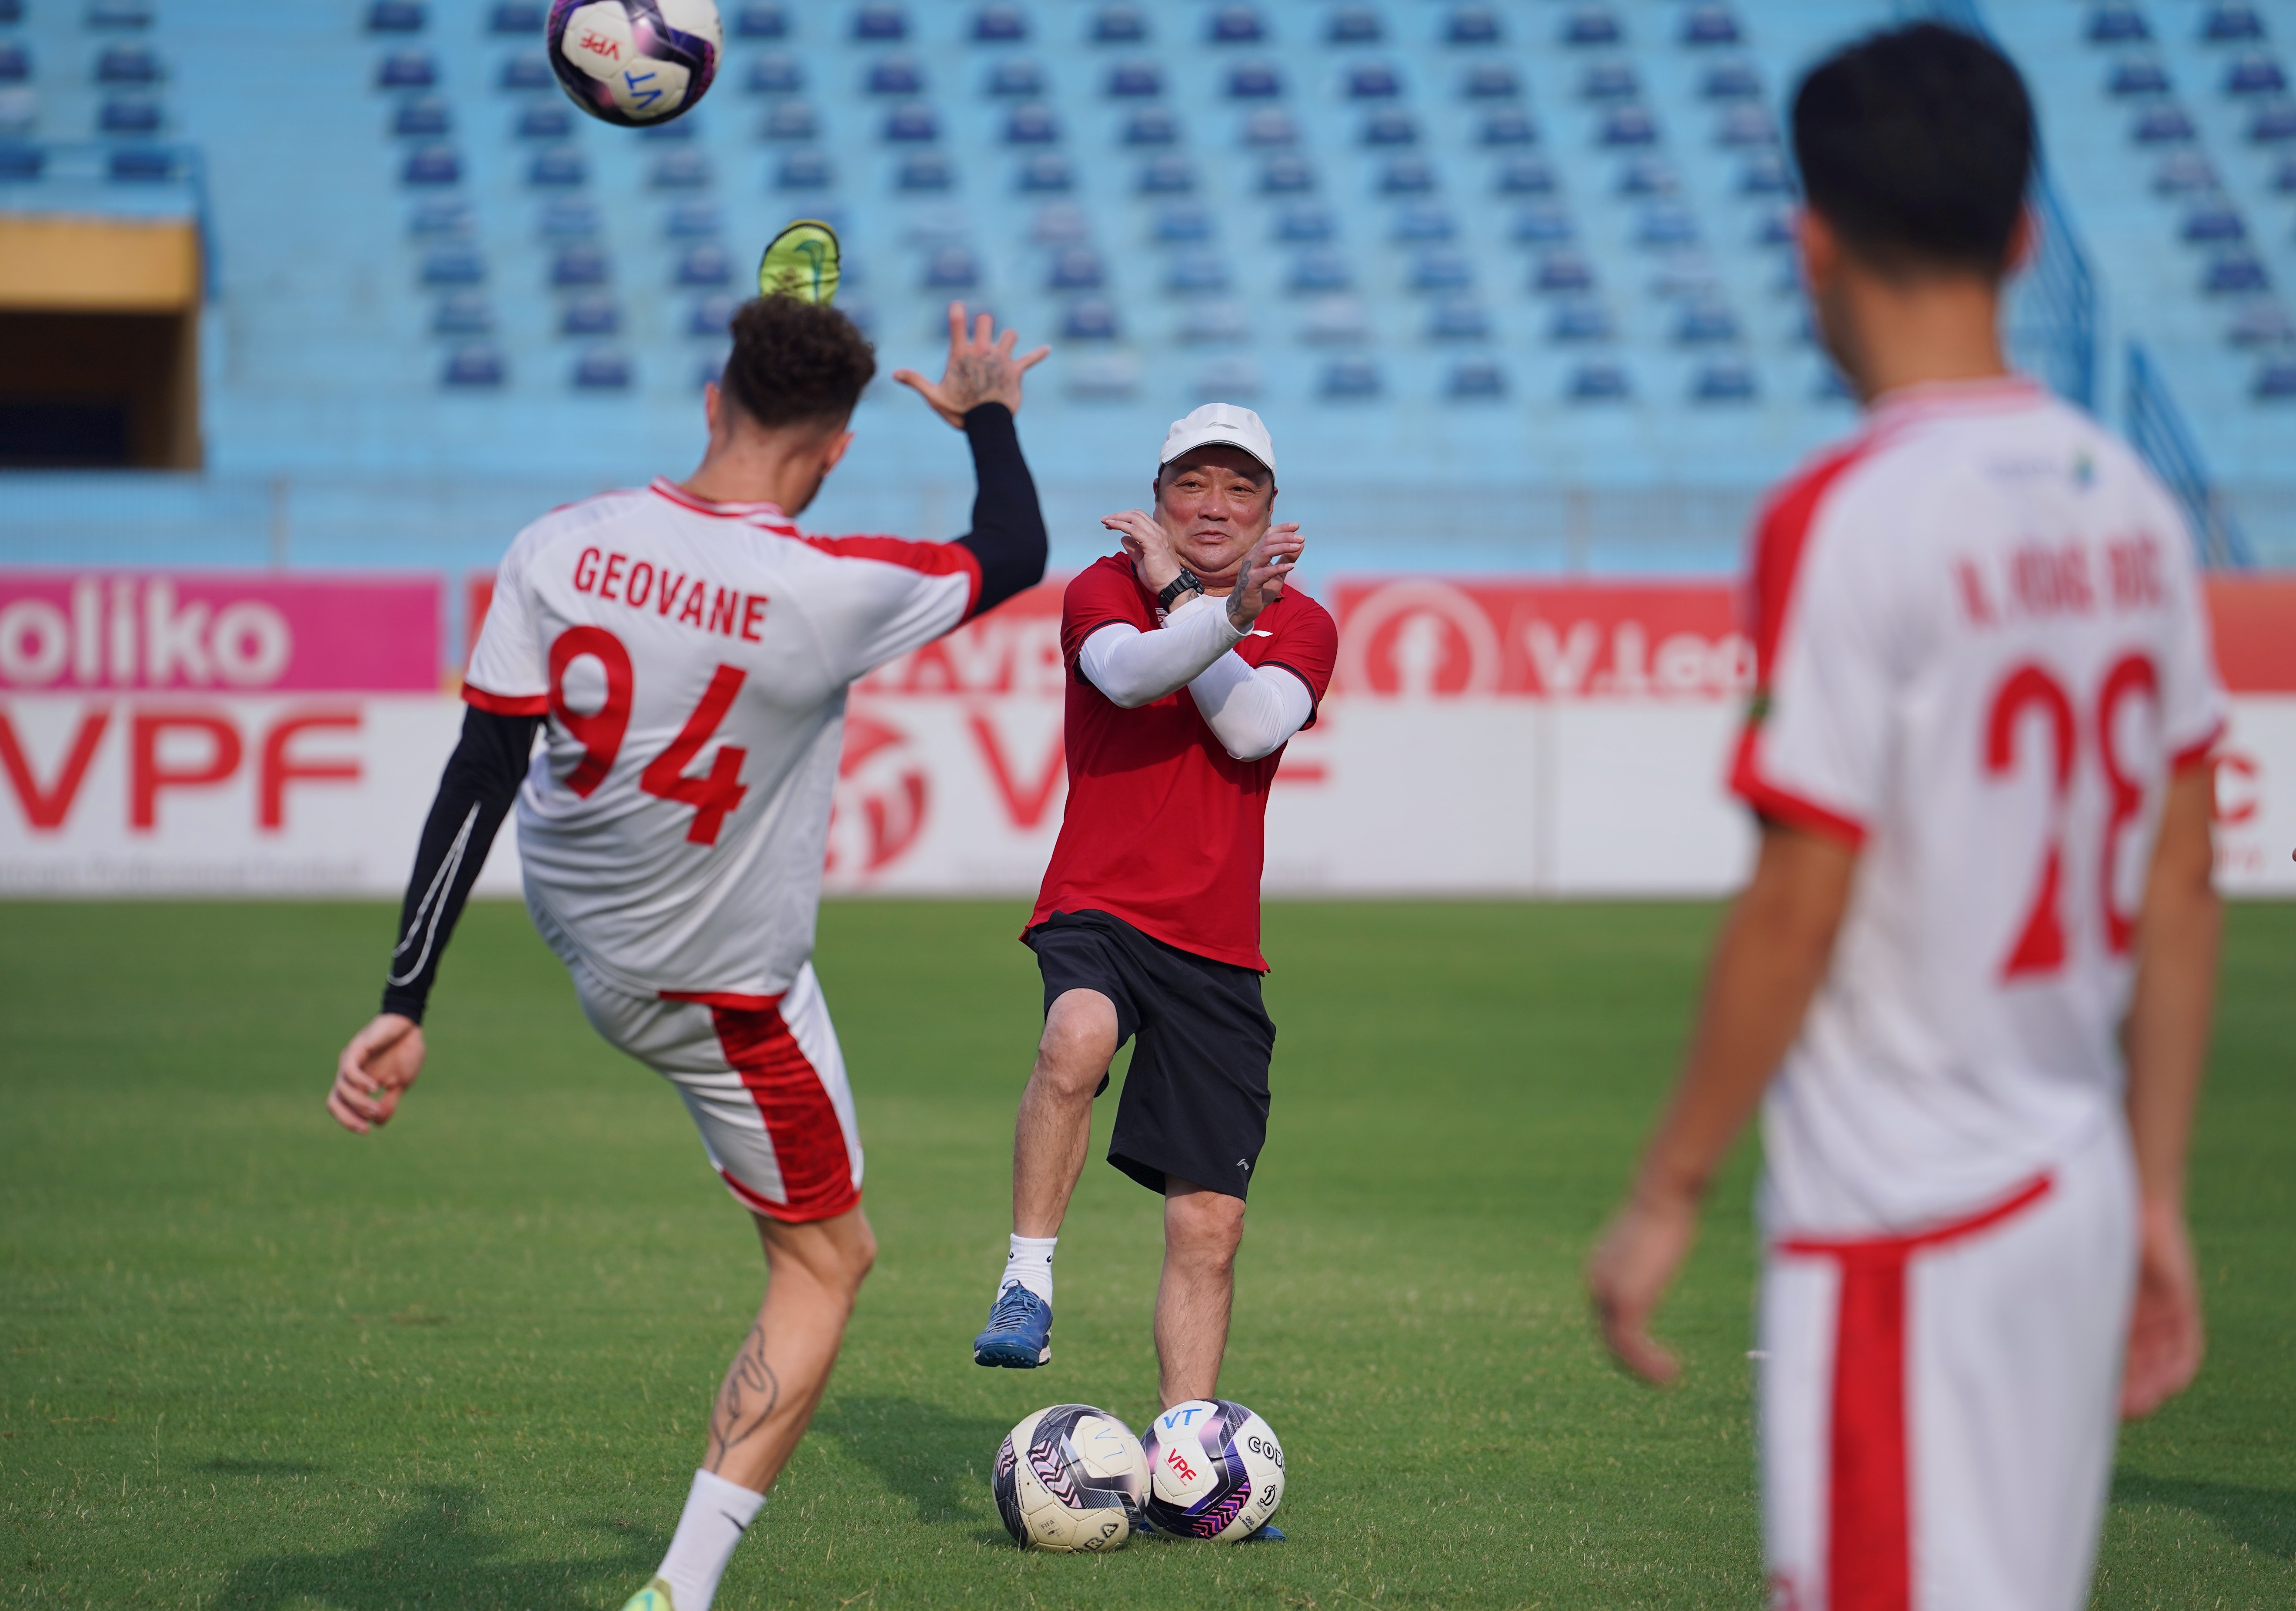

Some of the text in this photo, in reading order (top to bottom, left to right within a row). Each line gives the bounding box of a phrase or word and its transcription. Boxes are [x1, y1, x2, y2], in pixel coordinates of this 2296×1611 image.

[580, 33, 620, 62] VPF
[624, 71, 663, 110] VT
[574, 547, 768, 643] GEOVANE
[548, 624, 748, 847] 94
[0, 710, 361, 832] VPF
[1164, 1408, 1203, 1429] VT
[1168, 1448, 1197, 1481] VPF
[1041, 1519, 1055, 1529] FIFA
